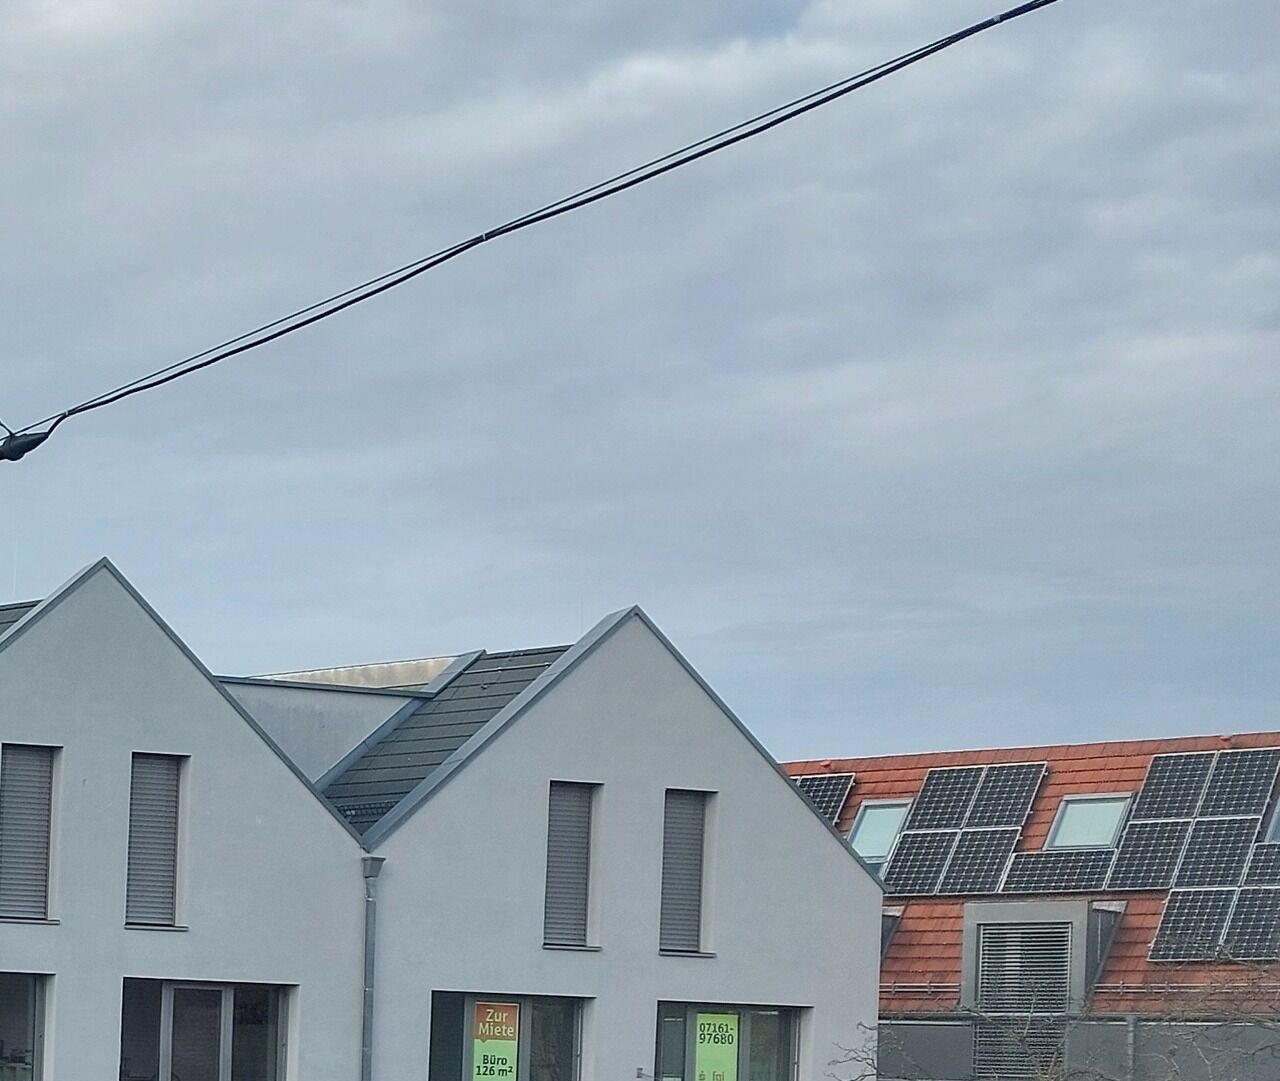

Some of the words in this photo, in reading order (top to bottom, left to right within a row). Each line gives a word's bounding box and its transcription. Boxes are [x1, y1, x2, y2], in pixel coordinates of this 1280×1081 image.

[485, 1008, 509, 1022] Zur
[478, 1022, 515, 1037] Miete
[699, 1022, 735, 1034] 07161-
[699, 1033, 735, 1045] 97680
[482, 1054, 508, 1066] Büro
[475, 1065, 496, 1076] 126
